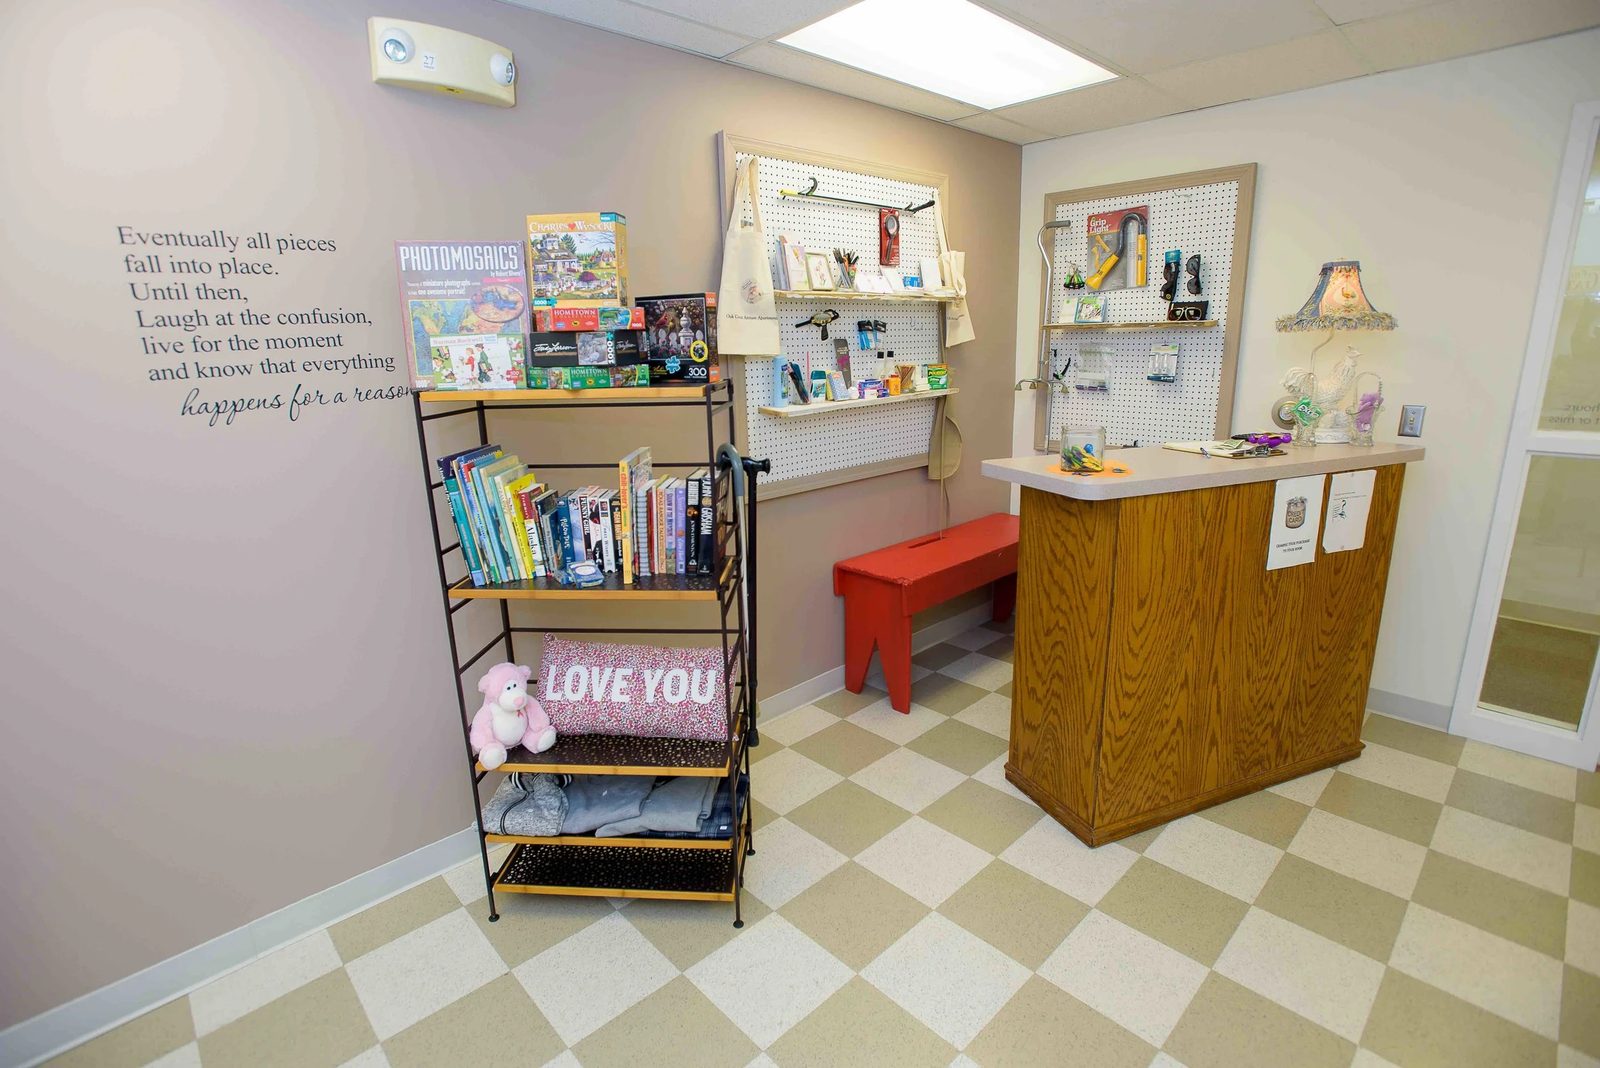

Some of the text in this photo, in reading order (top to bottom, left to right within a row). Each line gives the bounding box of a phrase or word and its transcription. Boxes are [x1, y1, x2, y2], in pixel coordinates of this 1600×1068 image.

[1090, 217, 1109, 234] Grip Light
[117, 226, 336, 254] Eventually all pieces
[124, 255, 278, 278] fall into place.
[400, 246, 519, 271] PHOTOMOSAICS
[129, 283, 248, 302] Until then,
[136, 308, 372, 331] Laugh at the confusion,
[141, 333, 343, 355] live for the moment
[149, 353, 395, 381] and know that everything
[689, 368, 706, 376] 300
[181, 388, 285, 426] happens
[289, 384, 330, 421] for
[334, 391, 347, 403] a
[580, 498, 588, 520] FUNNY
[700, 478, 712, 534] JOHN GRISHAM
[527, 527, 537, 554] Alaska
[545, 665, 719, 705] LOVE YOU
